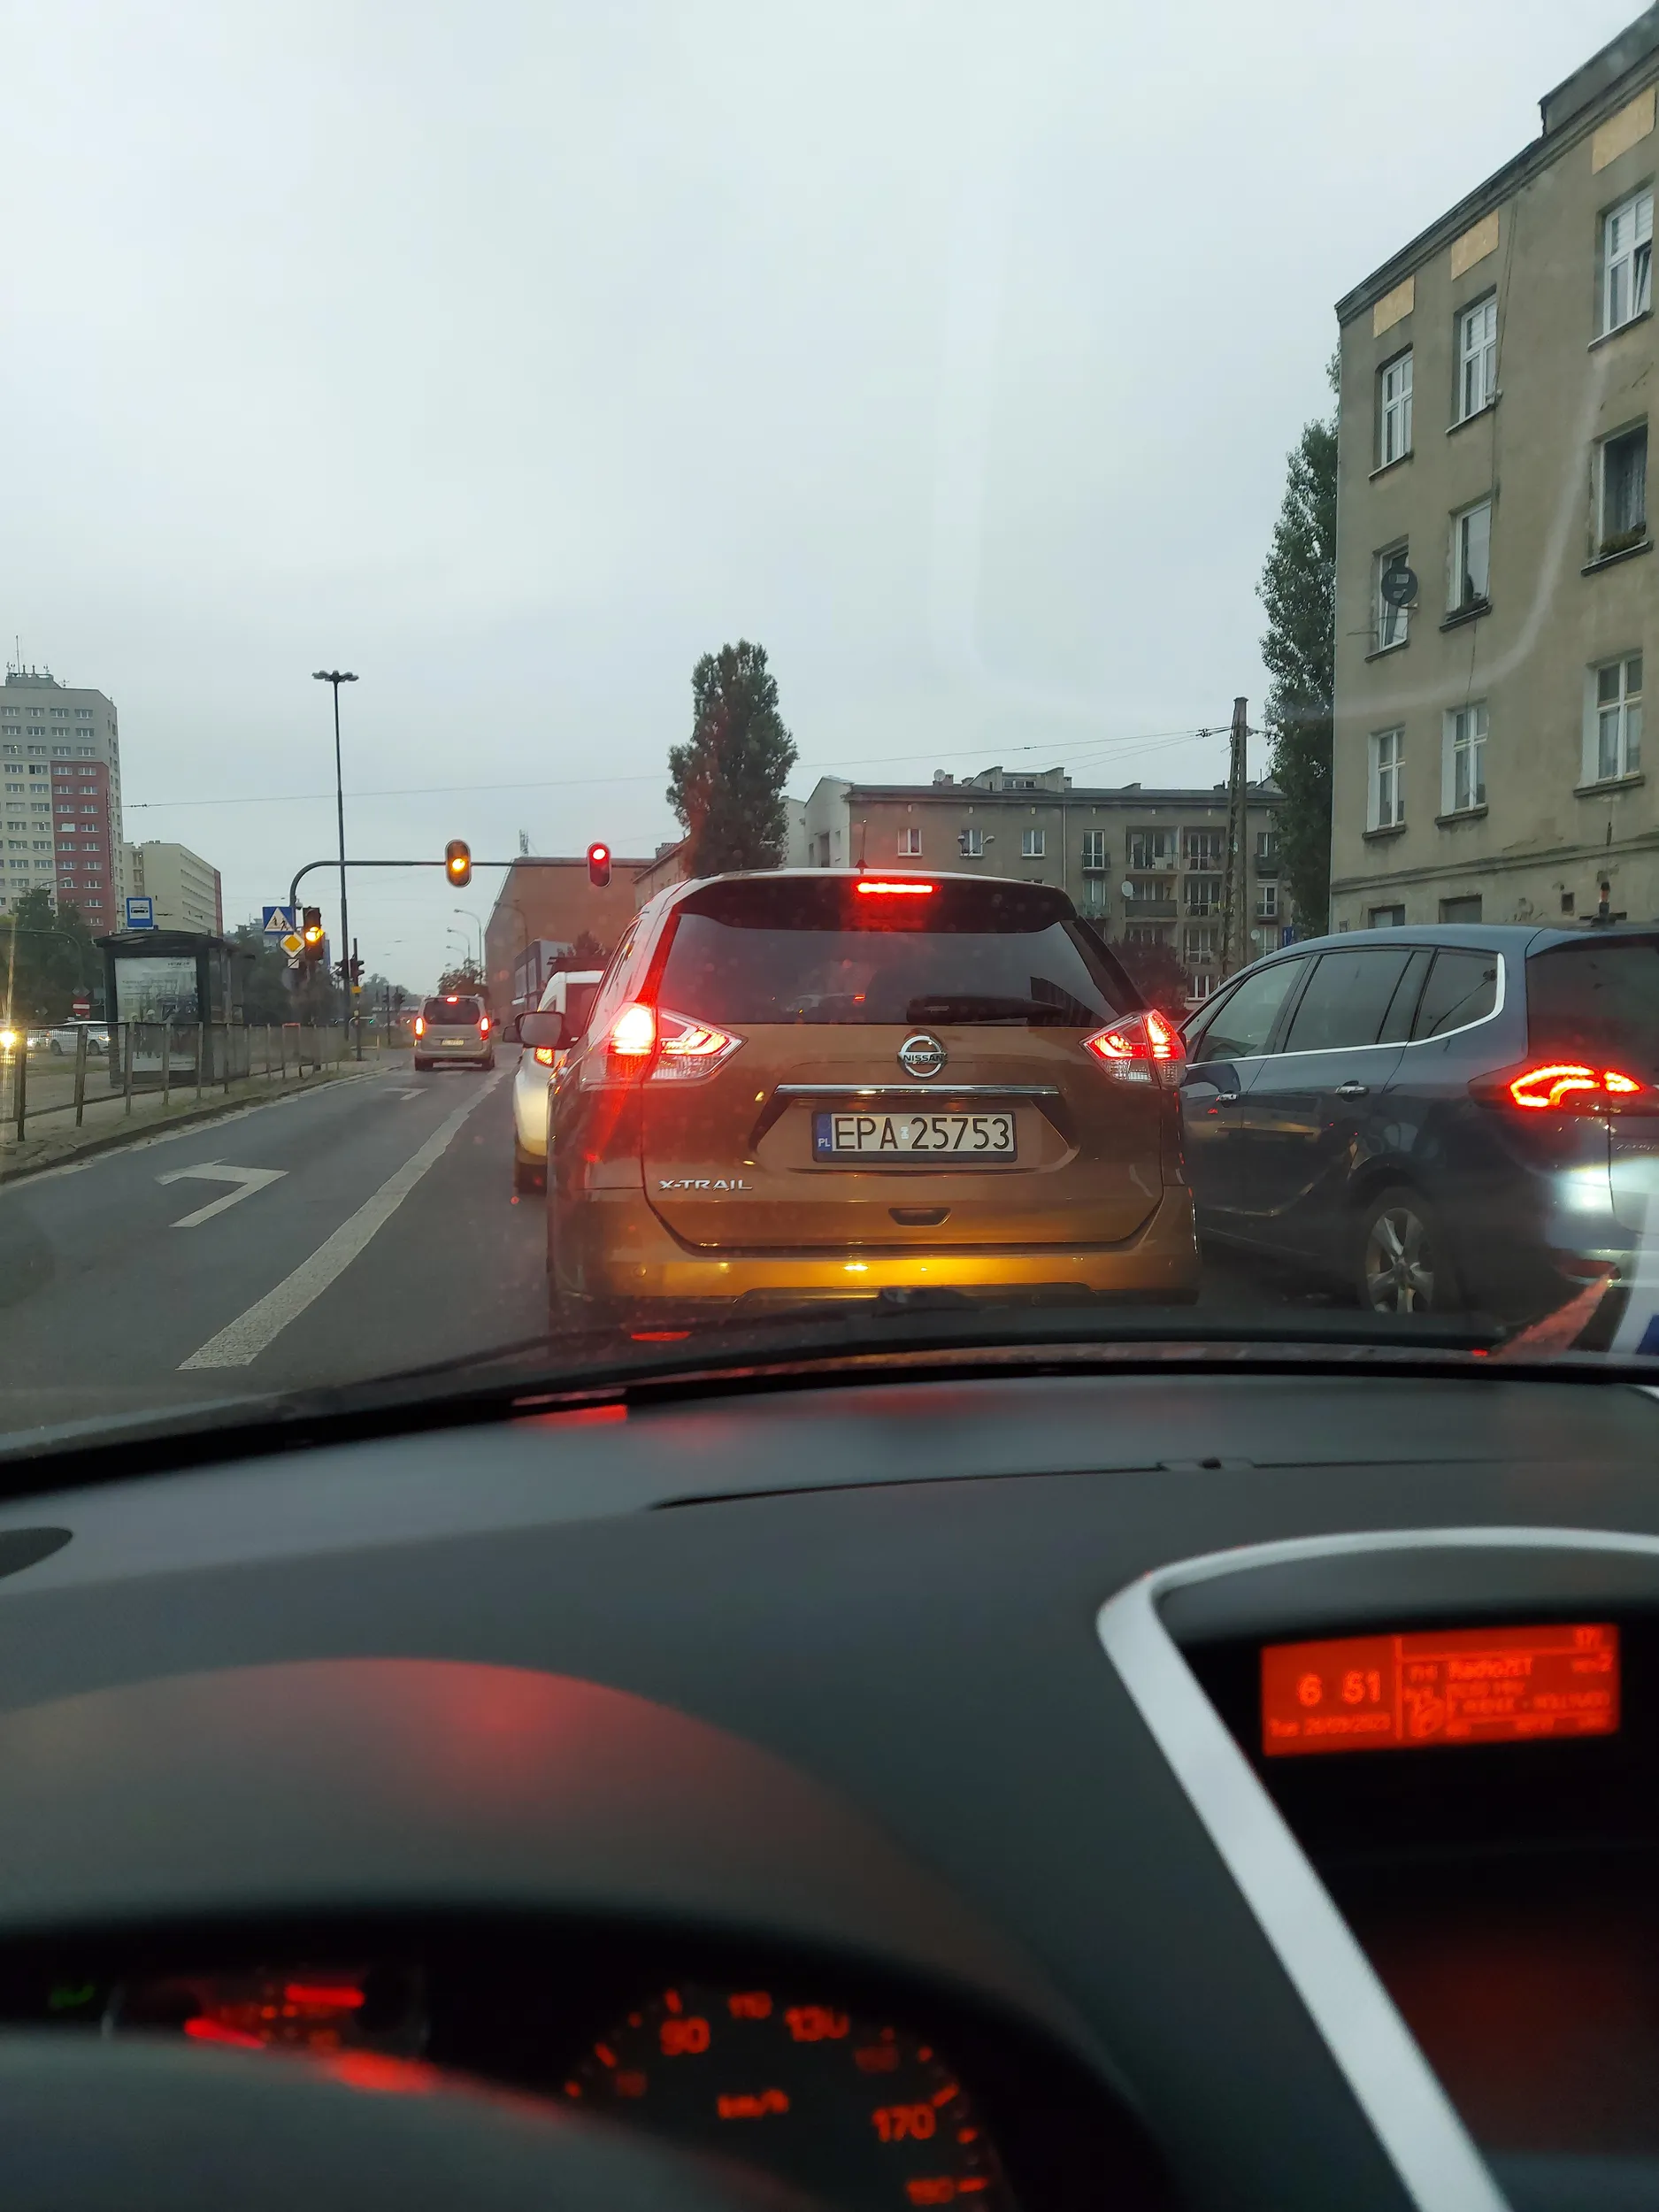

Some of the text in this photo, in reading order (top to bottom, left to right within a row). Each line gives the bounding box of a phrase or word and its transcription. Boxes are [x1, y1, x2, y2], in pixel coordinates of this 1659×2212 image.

[818, 1138, 831, 1148] PL
[834, 1117, 1010, 1149] EPA 25753
[658, 1179, 753, 1192] X-TRAIL
[872, 2104, 936, 2142] 170
